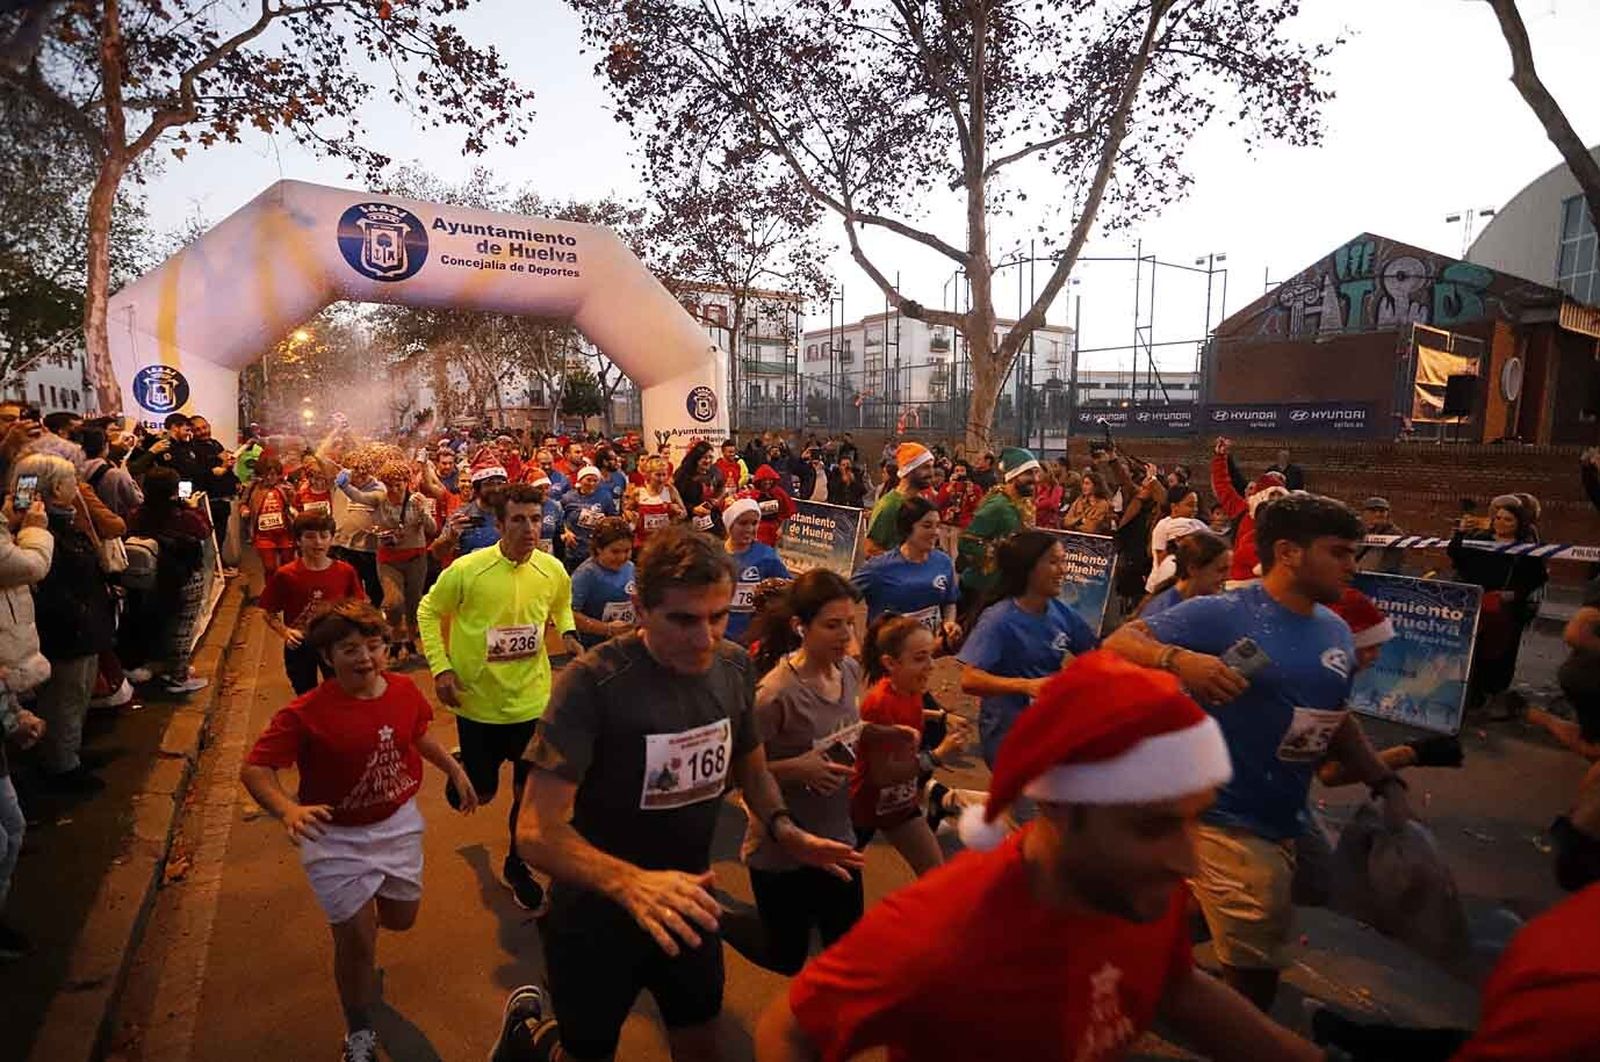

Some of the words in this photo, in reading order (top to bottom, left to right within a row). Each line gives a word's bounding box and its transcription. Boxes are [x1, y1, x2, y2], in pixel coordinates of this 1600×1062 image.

[432, 217, 577, 247] Ayuntamiento
[476, 239, 502, 256] de
[509, 242, 577, 263] Huelva
[509, 262, 525, 272] de
[528, 264, 580, 278] Deportes
[1230, 411, 1277, 420] HYUNDAI
[1311, 410, 1365, 419] HYUNDAI
[802, 525, 834, 540] Huelva
[1067, 562, 1105, 577] Huelva
[509, 635, 536, 652] 236
[687, 744, 725, 781] 168
